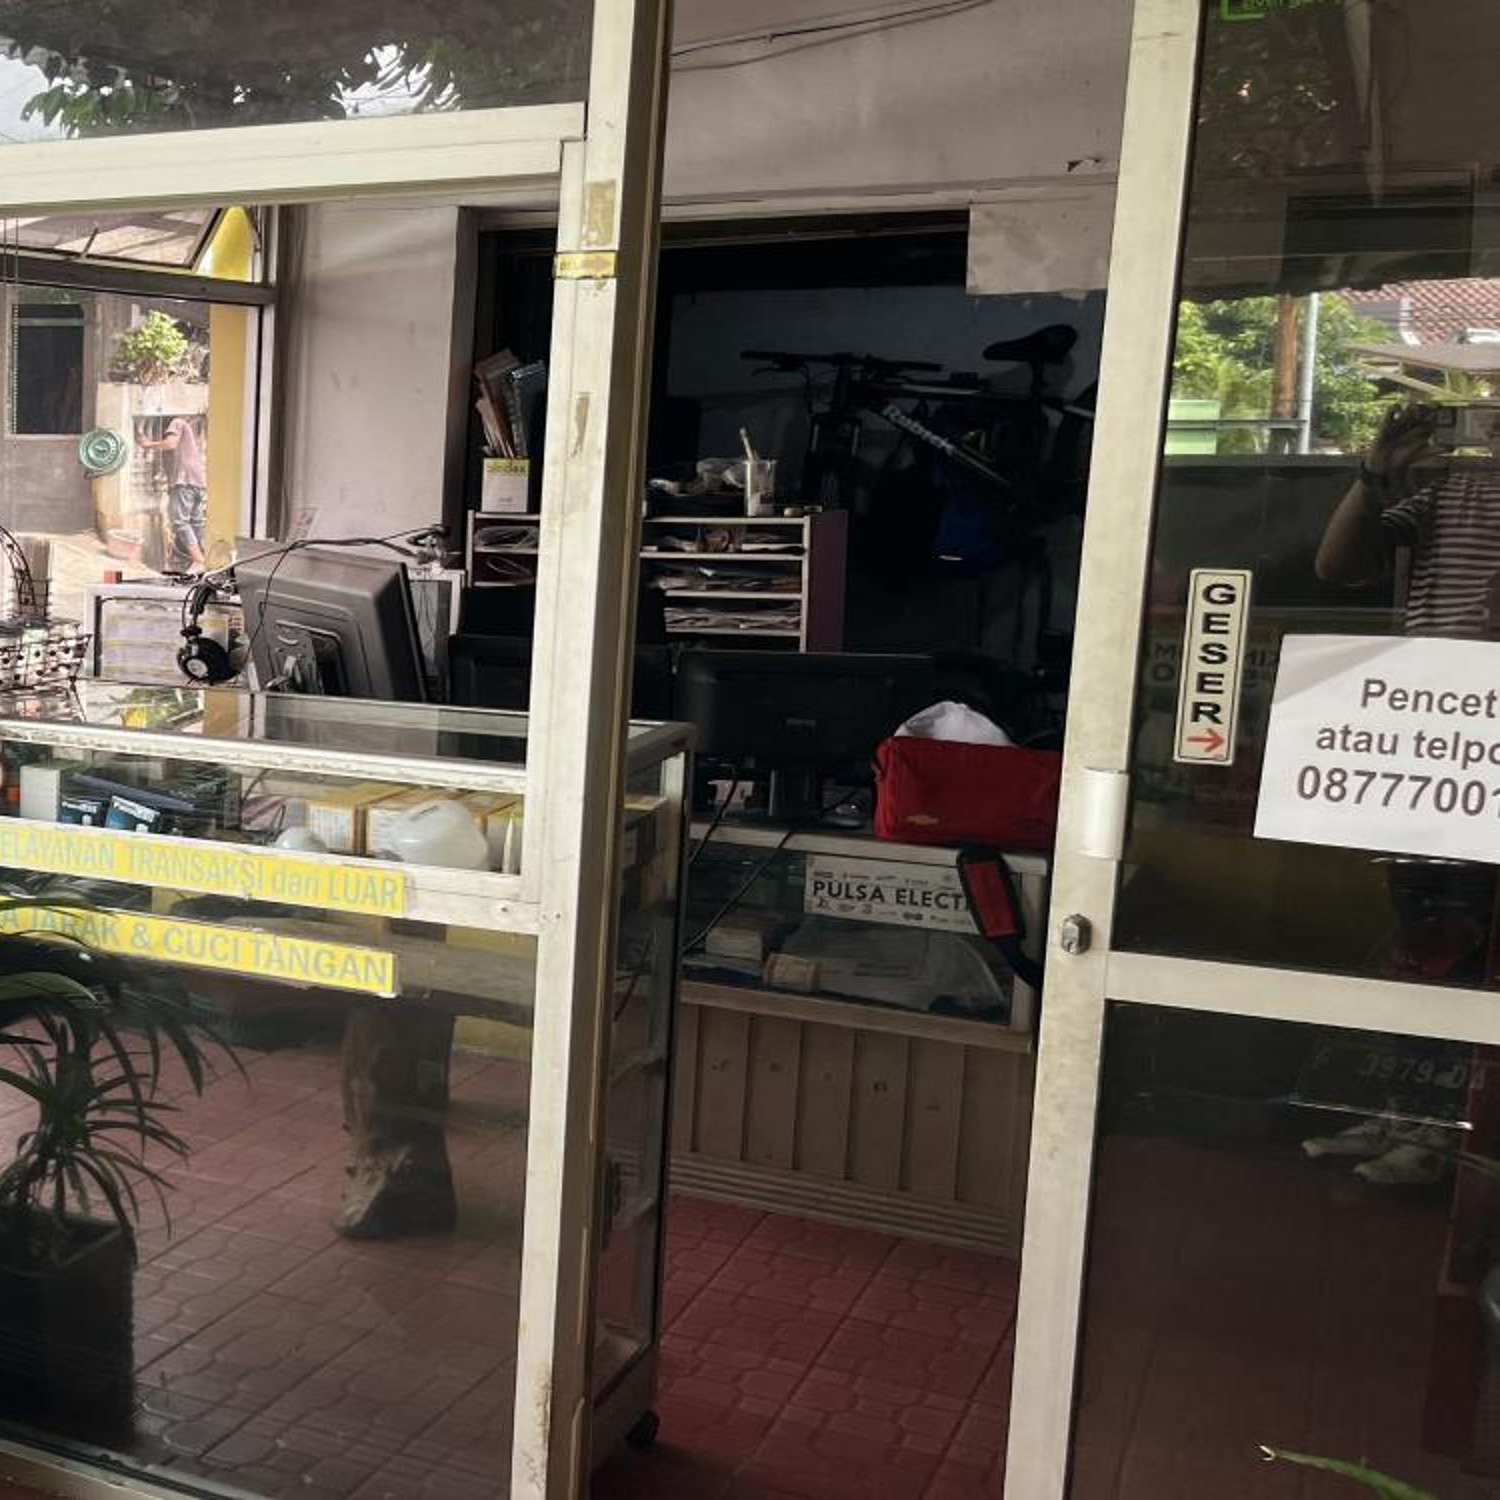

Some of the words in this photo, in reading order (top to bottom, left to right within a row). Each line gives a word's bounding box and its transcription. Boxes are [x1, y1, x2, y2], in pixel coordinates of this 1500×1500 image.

[1190, 582, 1237, 725] GESER
[1360, 678, 1499, 719] Pencet
[1315, 723, 1399, 756] atau
[132, 843, 264, 891] TRANSAKSI
[273, 861, 323, 898] dan
[328, 866, 398, 906] LUAR
[813, 879, 886, 903] PULSA
[131, 920, 151, 951] &
[163, 926, 240, 962] CUCI
[250, 936, 388, 986] TANGAN
